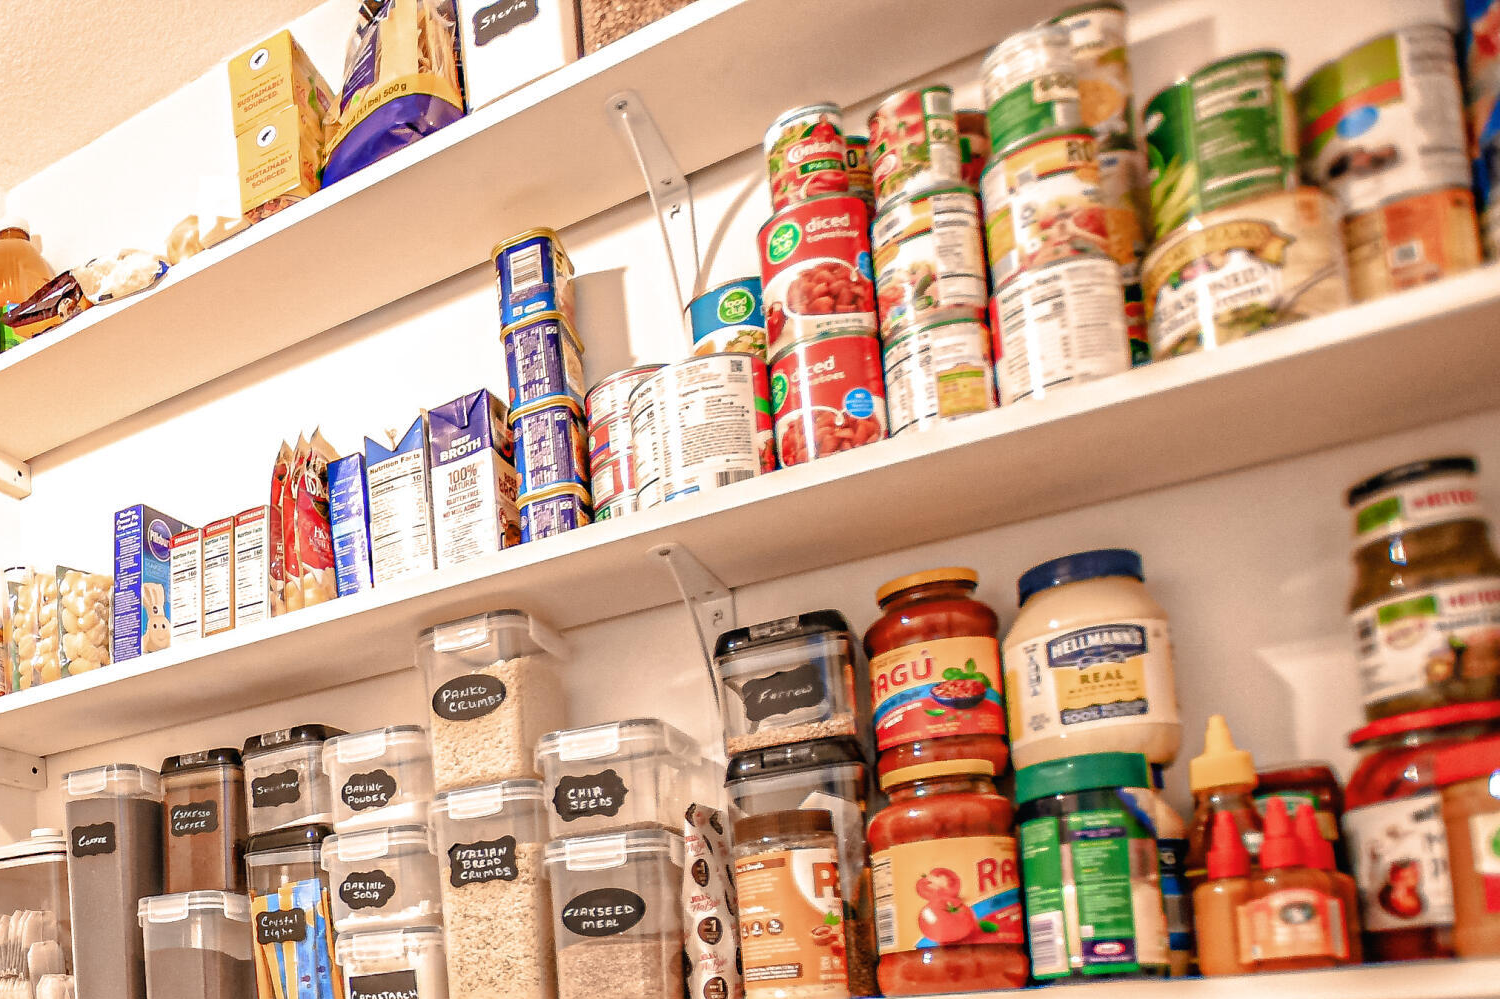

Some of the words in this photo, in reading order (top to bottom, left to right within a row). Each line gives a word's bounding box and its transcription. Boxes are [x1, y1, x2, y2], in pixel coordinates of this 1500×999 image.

[237, 77, 285, 108] SUSTAINABLY
[383, 83, 400, 97] 500
[245, 154, 293, 184] SUSTAINABLY
[805, 213, 850, 232] diced
[790, 355, 836, 383] dced
[439, 437, 482, 462] BROTH
[369, 460, 399, 474] Nutrition
[400, 453, 420, 464] Fats
[447, 463, 477, 484] 100%
[448, 476, 477, 493] NATURAL
[1079, 669, 1124, 685] REAL
[441, 685, 487, 703] PANKO
[449, 692, 502, 713] CRUMBS
[343, 783, 385, 795] BAKING
[567, 786, 603, 800] CHIA
[346, 793, 387, 804] POWDER
[569, 796, 612, 810] SEEDS
[461, 857, 502, 869] BREAD
[460, 867, 512, 880] CRUMBS
[343, 881, 386, 892] BAKING
[352, 890, 380, 900] SODA
[563, 904, 635, 918] FLAXSEED
[581, 918, 620, 929] MEAL
